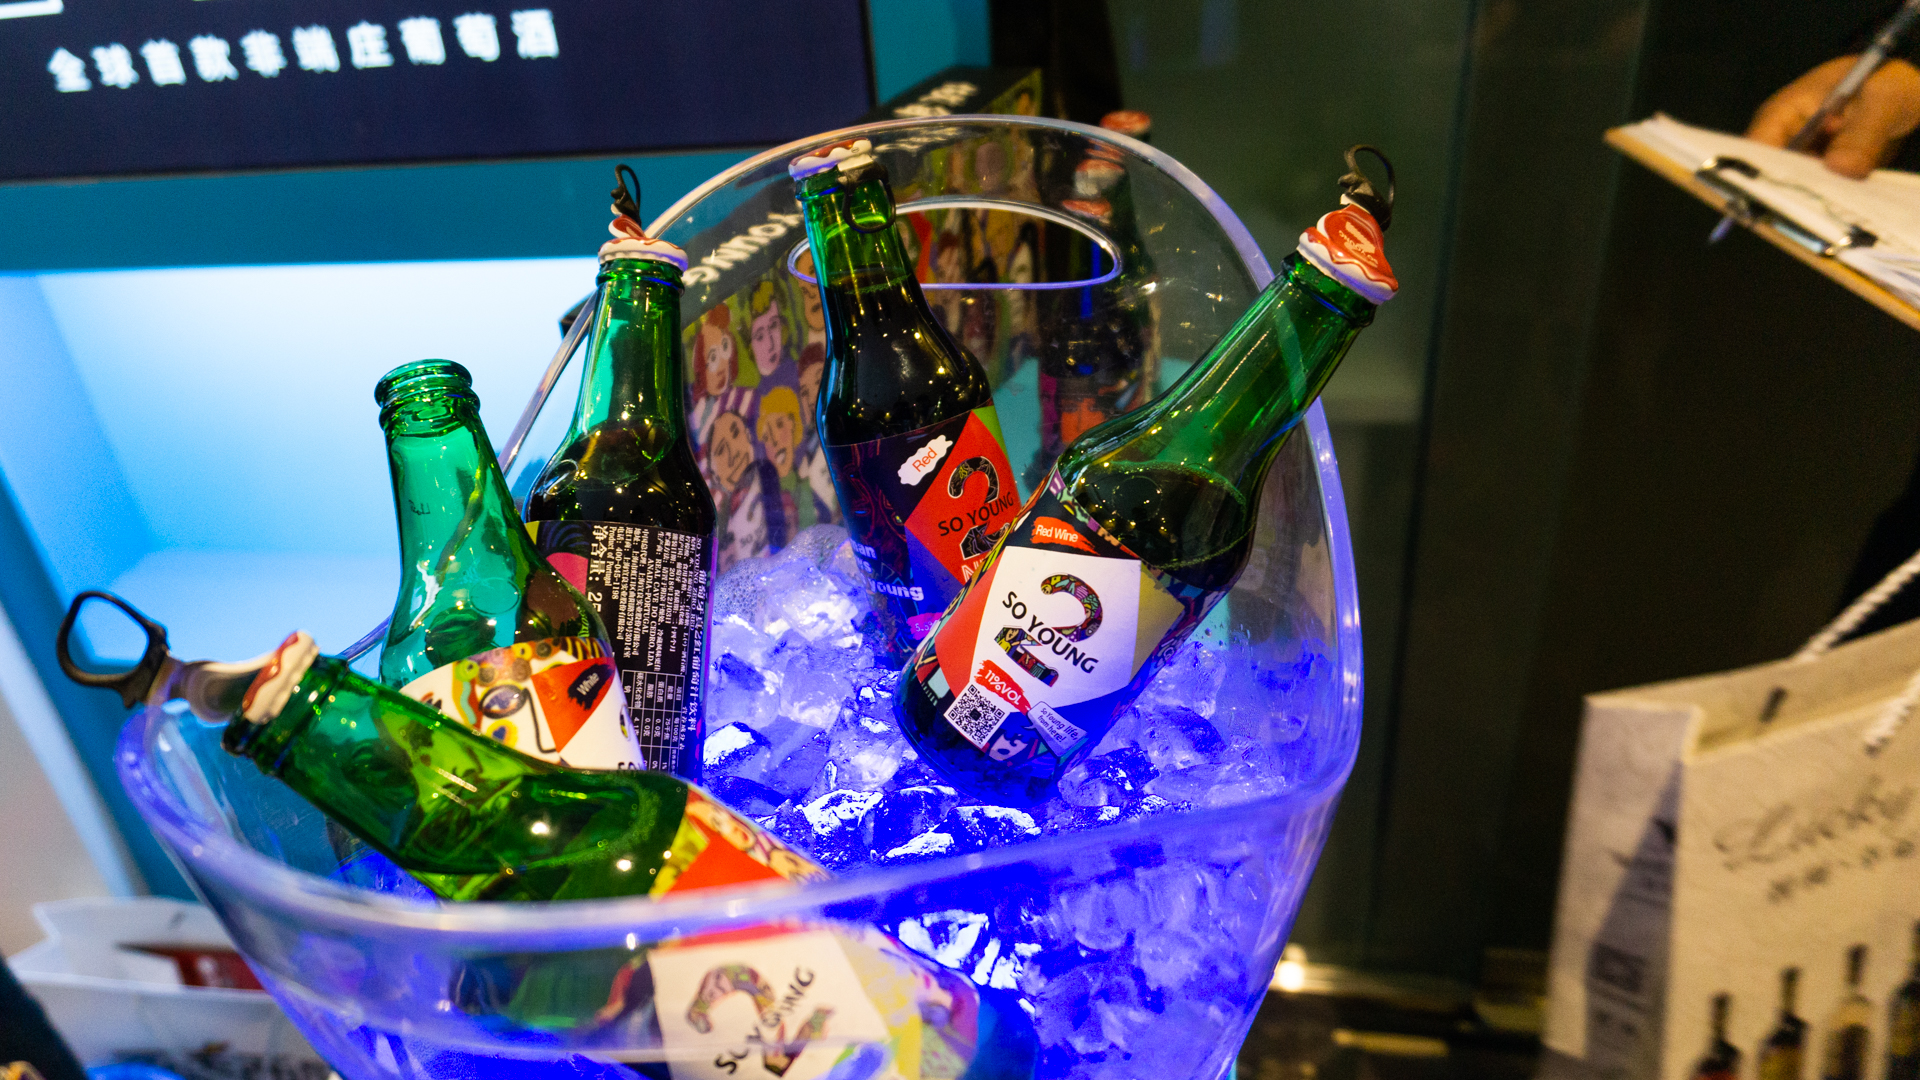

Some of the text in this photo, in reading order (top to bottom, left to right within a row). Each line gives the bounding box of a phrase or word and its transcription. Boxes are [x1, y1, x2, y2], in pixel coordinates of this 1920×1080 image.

[912, 447, 938, 472] Red
[938, 492, 1014, 537] SO YOUNG
[607, 526, 616, 550] Product
[696, 537, 702, 549] SO
[1036, 525, 1078, 542] Red Wine
[603, 560, 613, 586] Portugal
[641, 557, 654, 634] ANADIA-PORTUGAL
[651, 582, 659, 602] CAVE
[867, 579, 924, 601] young
[650, 606, 657, 617] DO
[1002, 591, 1099, 674] SO YOUNG
[576, 672, 600, 695] White
[633, 672, 643, 707] 碳水化合物
[646, 683, 653, 698] 脂肪
[656, 680, 664, 702] 蛋白质
[666, 685, 673, 700] 能量
[984, 669, 1021, 705] 11%VOL
[1037, 714, 1068, 744] from here!
[1040, 706, 1049, 717] So
[1047, 711, 1066, 731] Young
